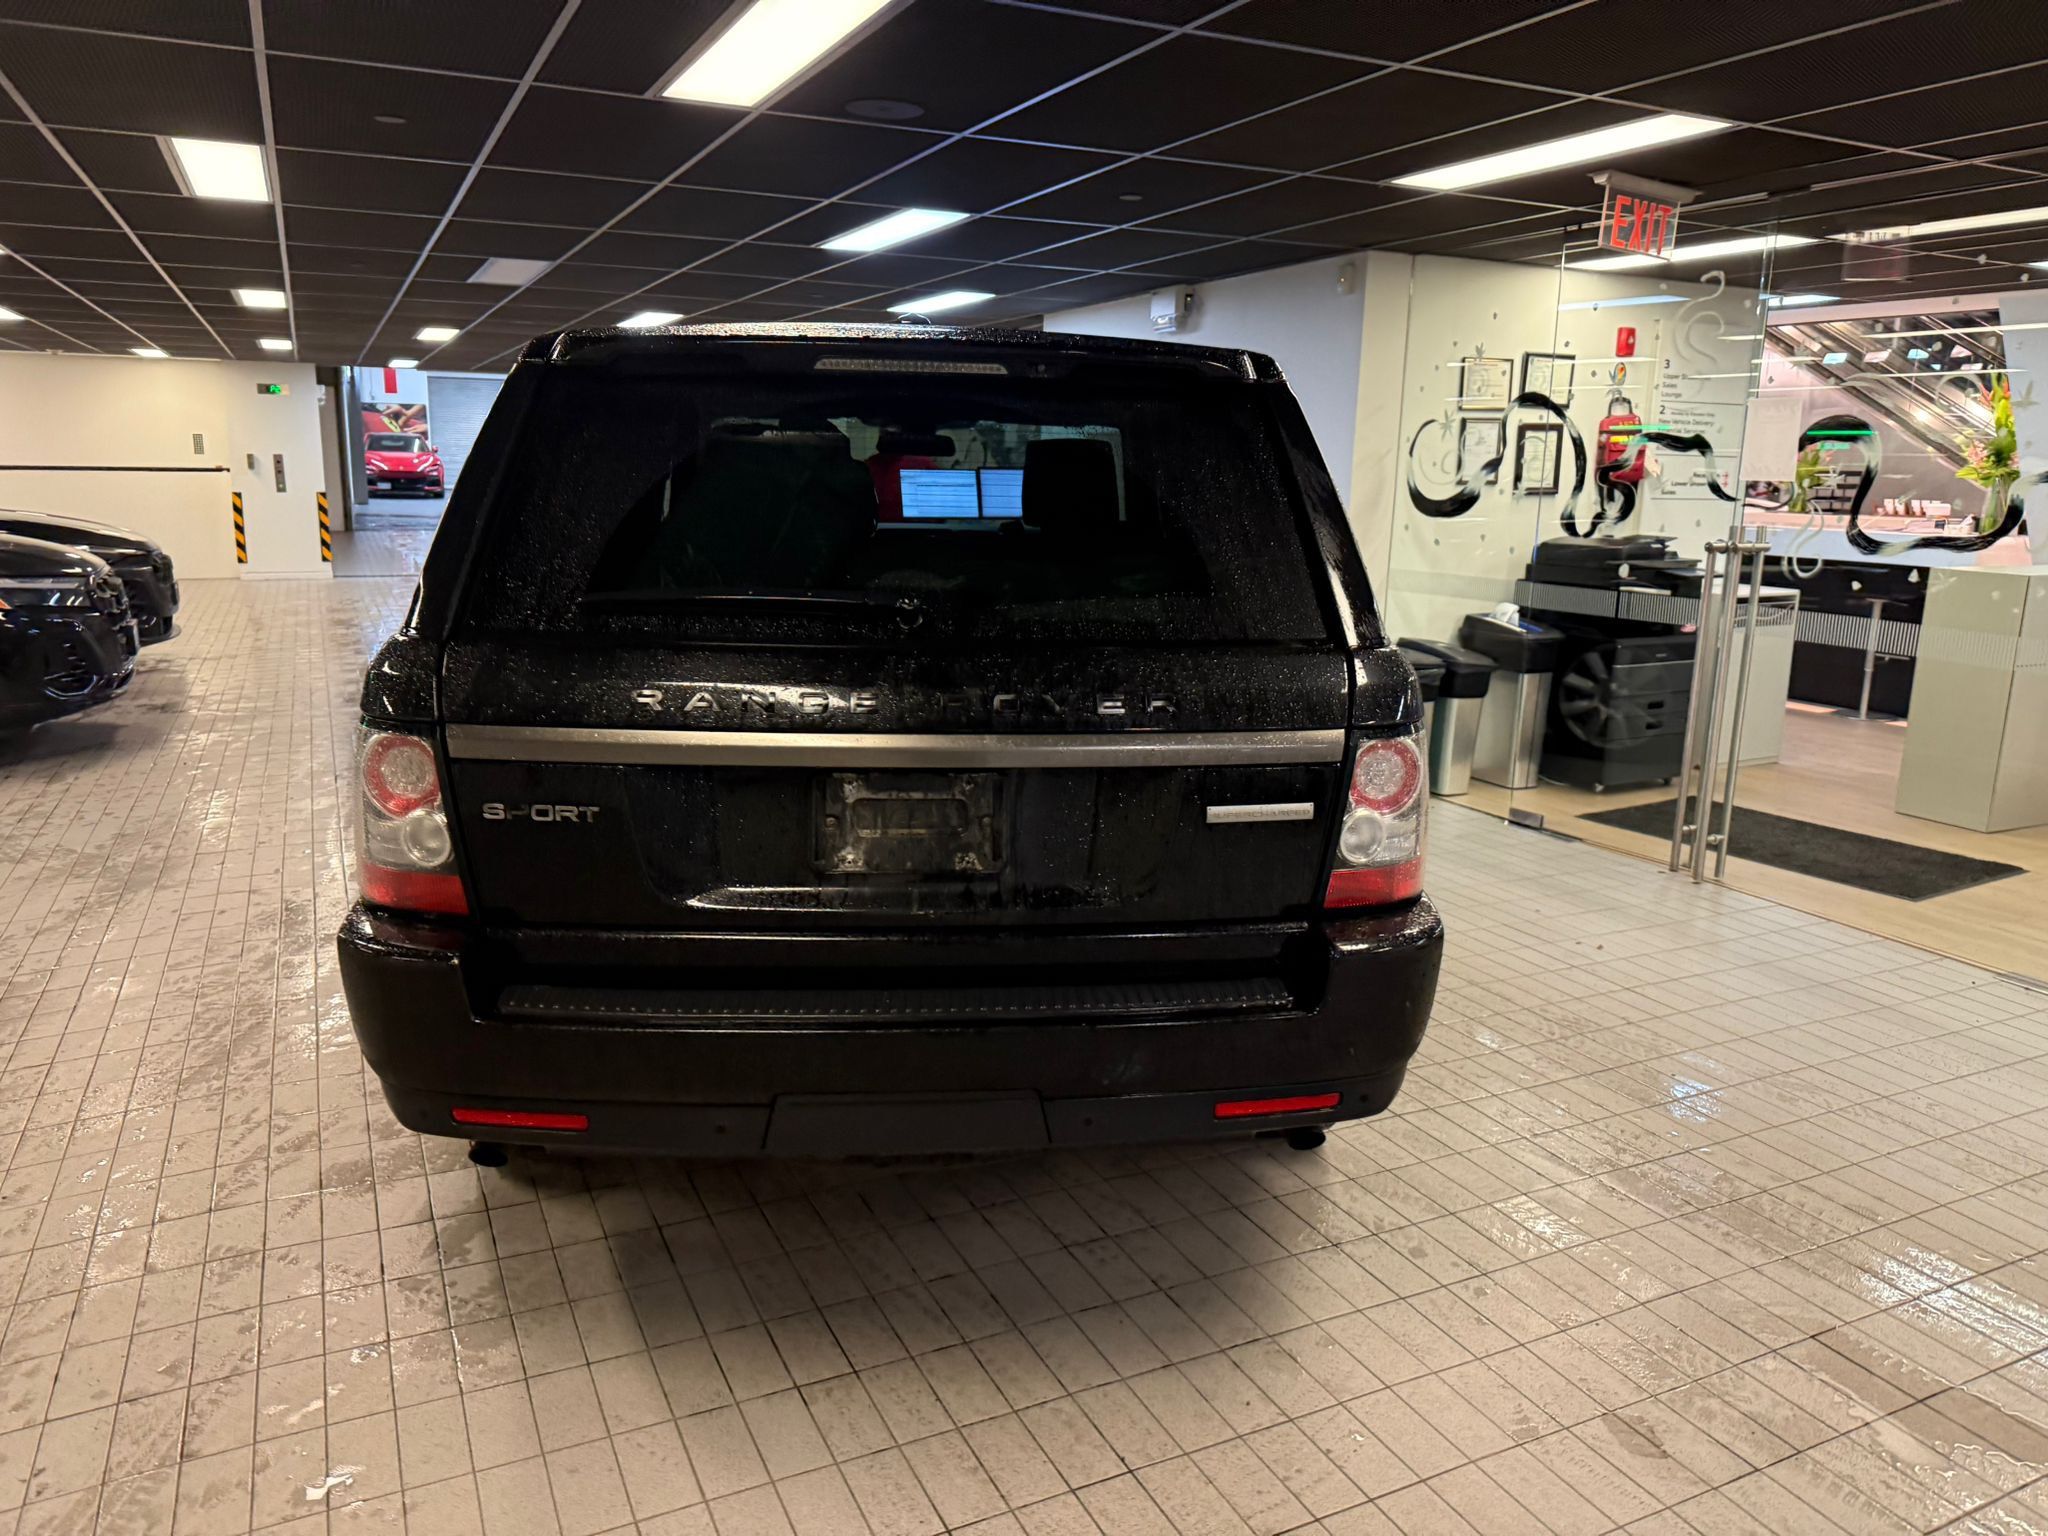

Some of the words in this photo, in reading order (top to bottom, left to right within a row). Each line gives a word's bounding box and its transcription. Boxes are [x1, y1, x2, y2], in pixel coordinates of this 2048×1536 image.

[1610, 194, 1673, 255] EXIT
[1663, 358, 1671, 369] 3
[1659, 404, 1666, 415] 2
[631, 688, 880, 715] RANGE
[481, 802, 601, 823] SPORT
